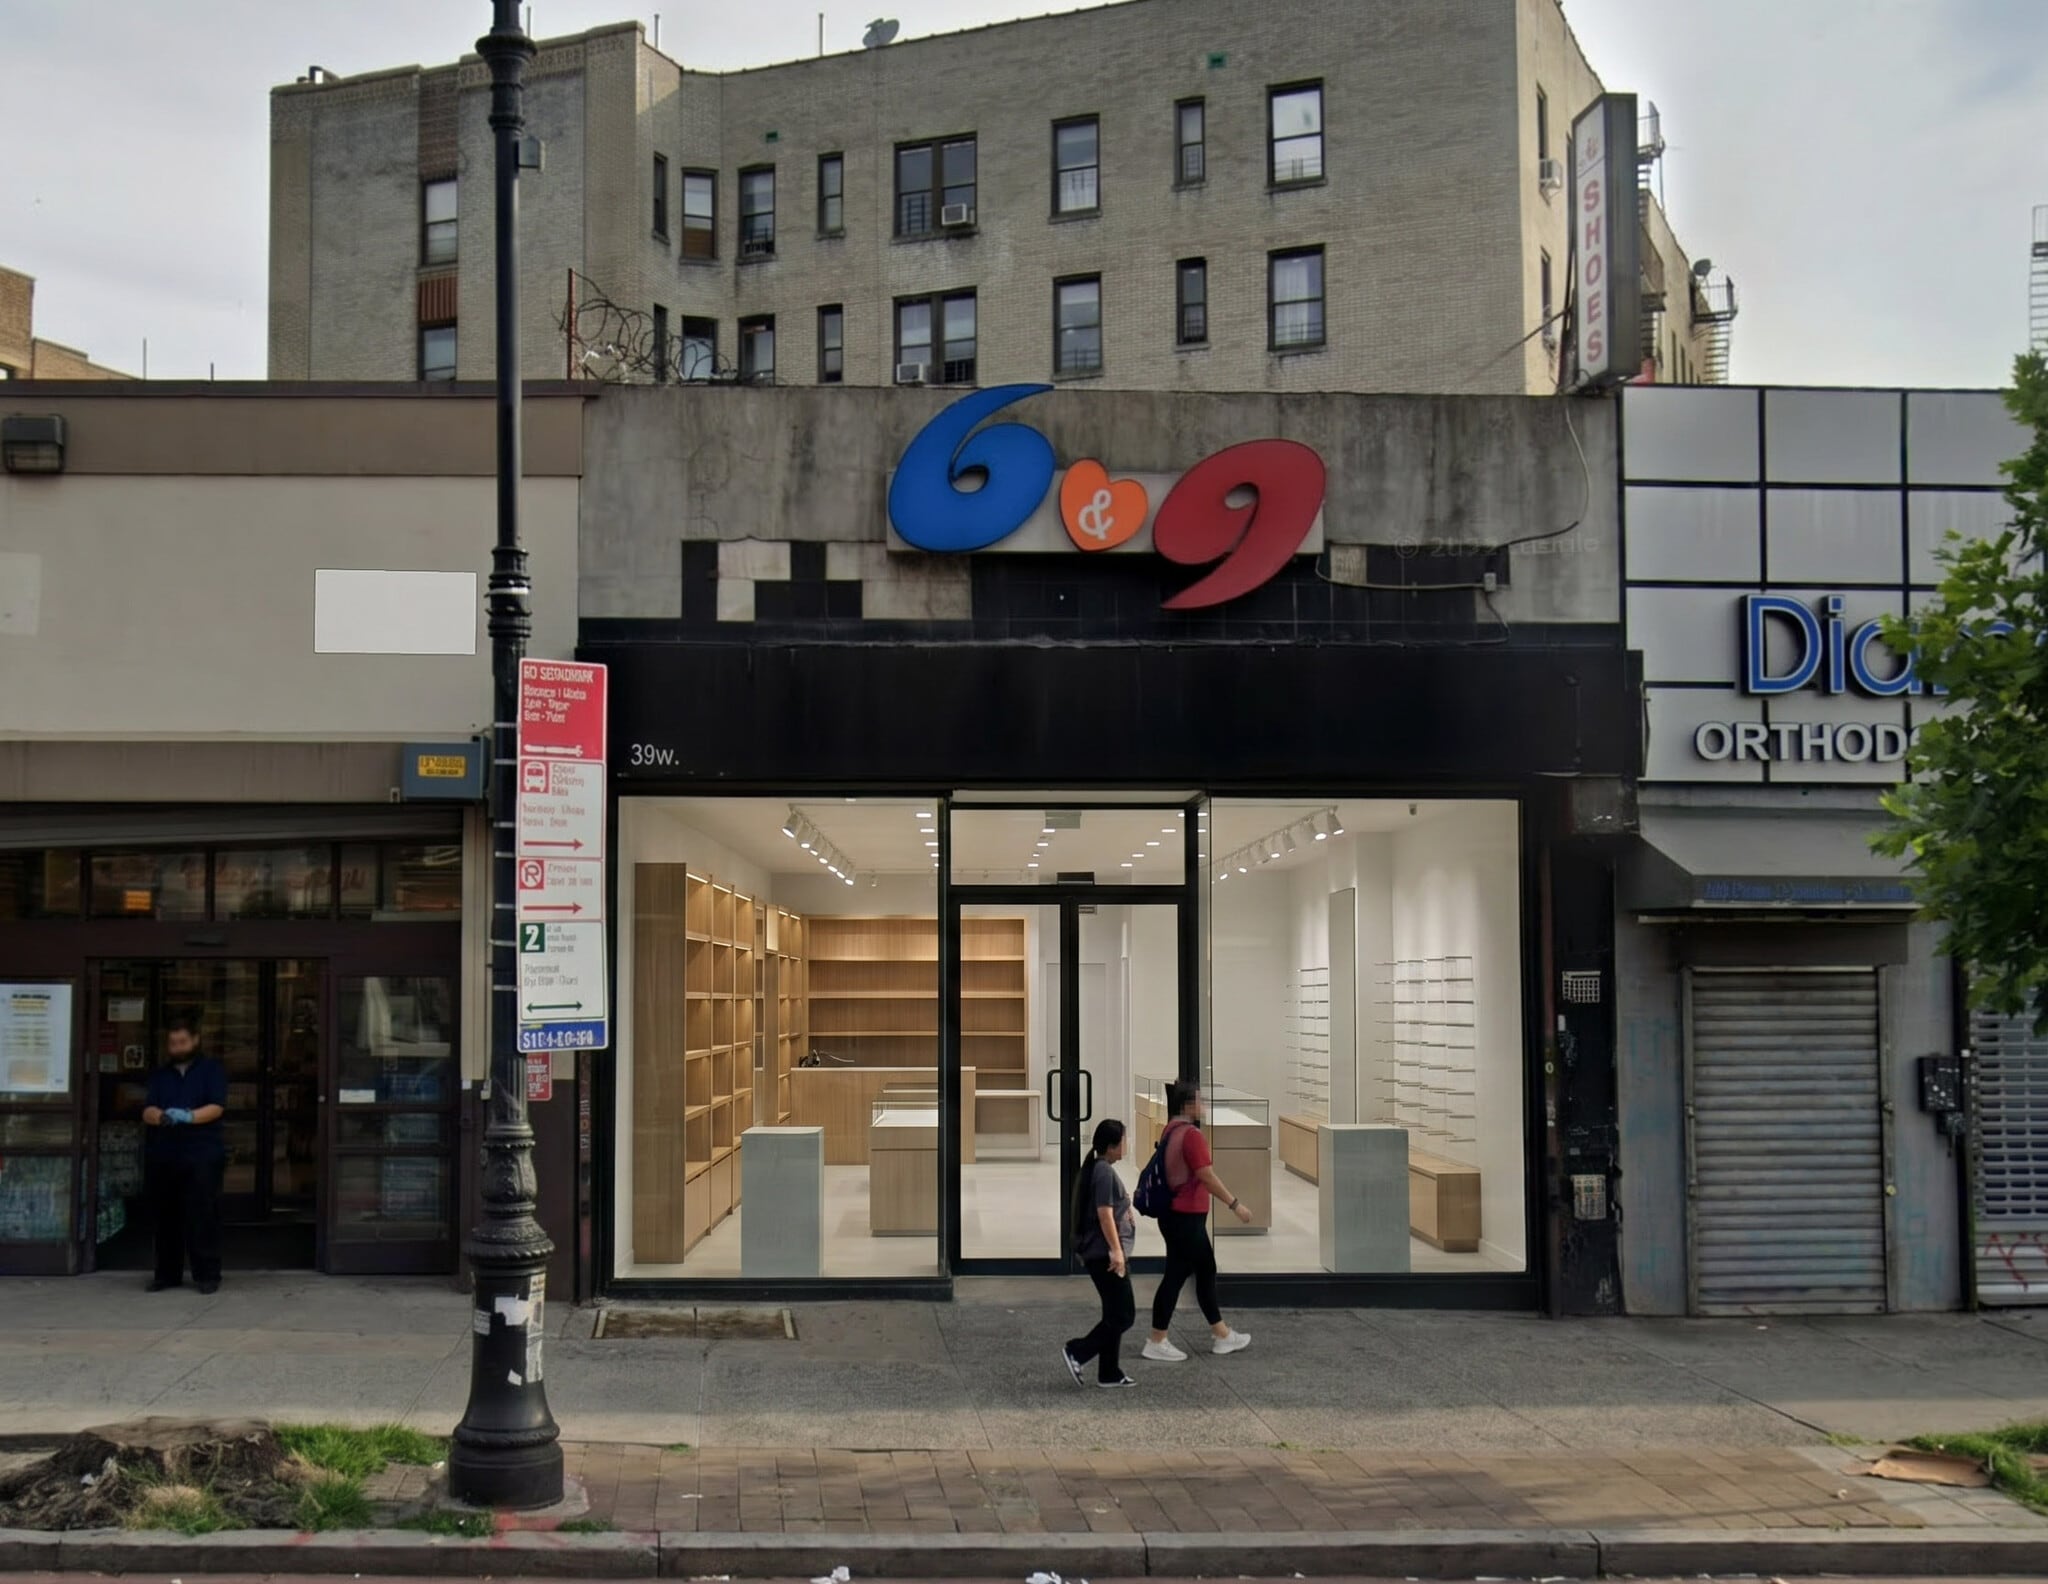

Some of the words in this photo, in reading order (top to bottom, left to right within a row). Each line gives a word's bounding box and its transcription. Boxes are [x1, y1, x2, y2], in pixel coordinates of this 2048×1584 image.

[1584, 180, 1602, 362] SHOES
[888, 384, 1055, 551] 6
[1077, 488, 1113, 540] &
[1152, 438, 1327, 609] 9
[1746, 593, 2017, 696] Dia
[630, 743, 680, 766] 39w.
[1694, 721, 1926, 764] ORTHOD
[524, 924, 541, 951] 2
